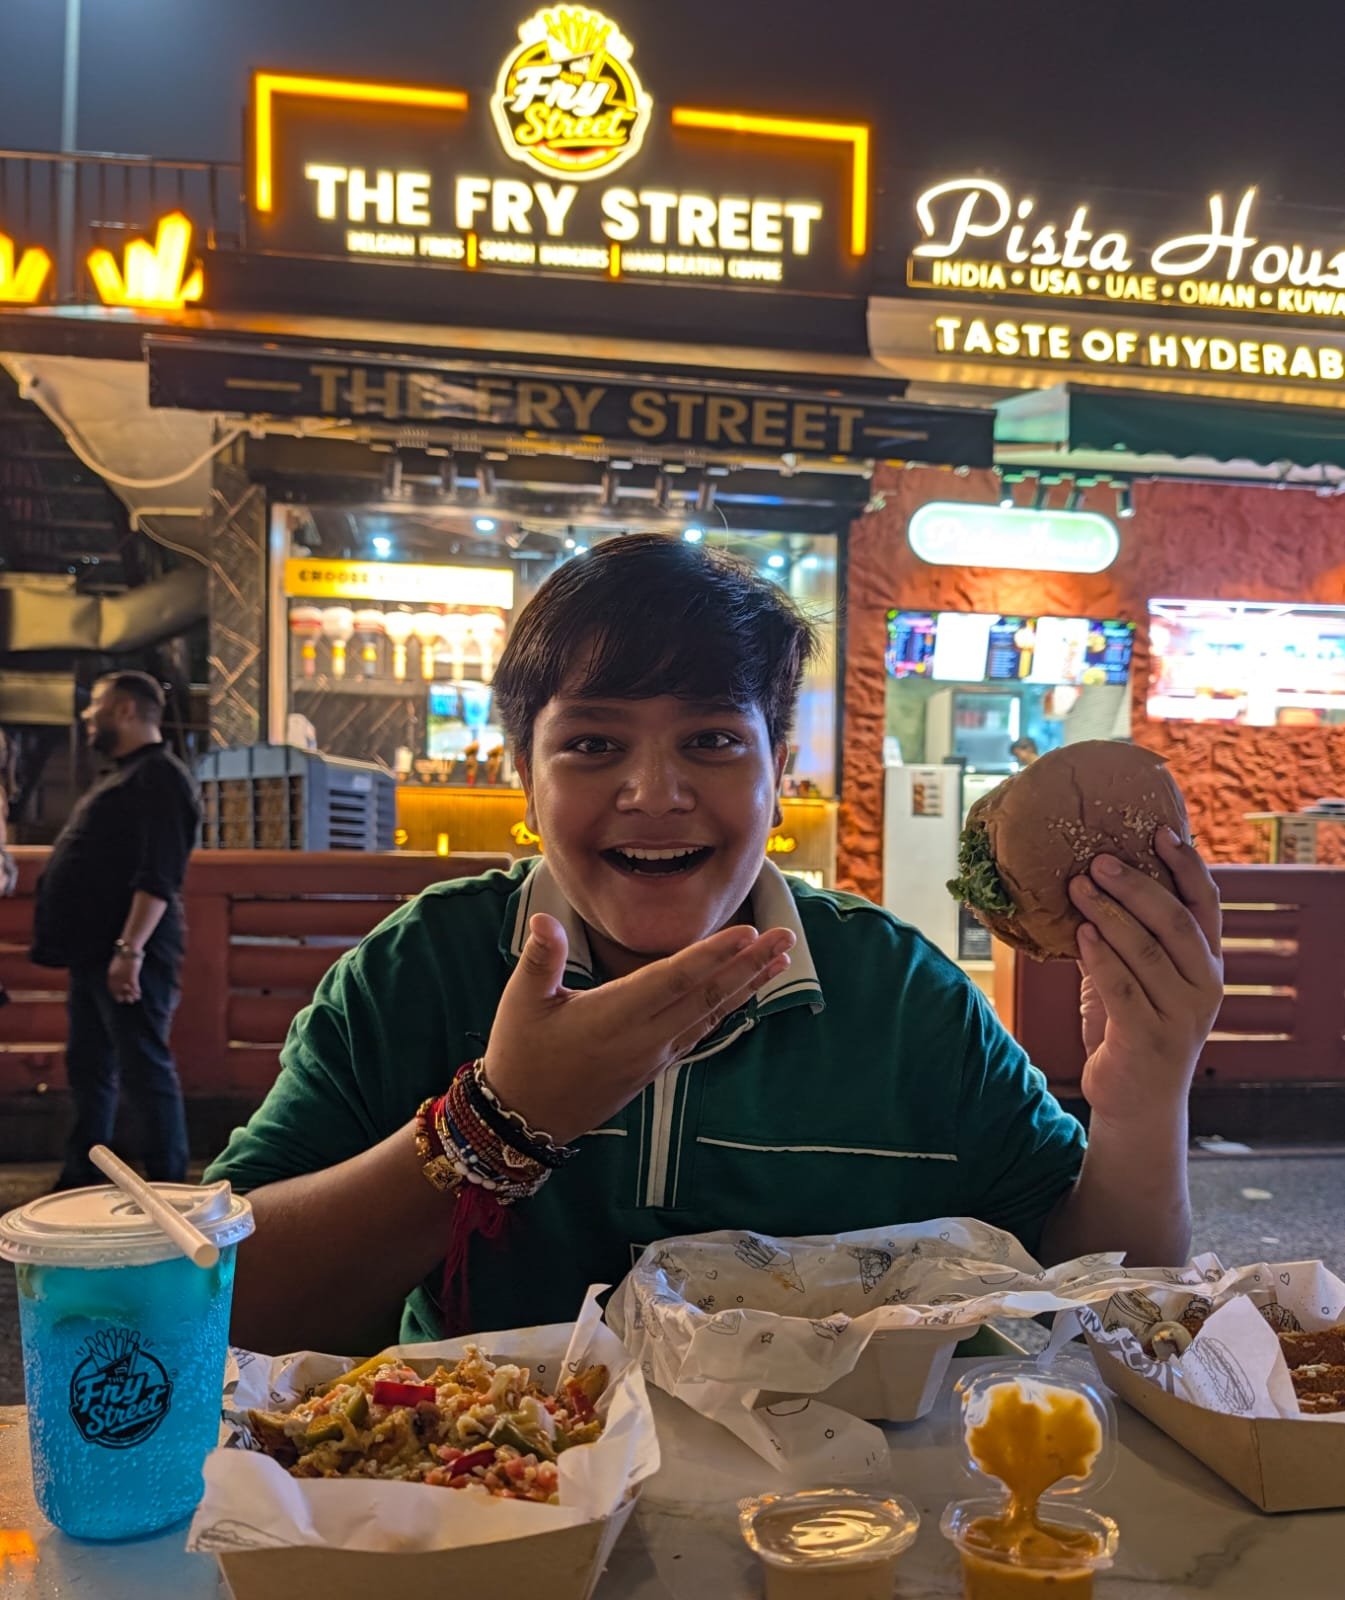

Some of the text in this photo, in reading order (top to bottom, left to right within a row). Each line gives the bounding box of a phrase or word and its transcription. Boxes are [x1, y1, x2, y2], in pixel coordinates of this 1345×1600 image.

[510, 64, 610, 117] Fry
[515, 102, 636, 142] Street
[305, 163, 822, 255] THE FRY STREET
[912, 178, 1133, 271] Pista
[932, 261, 1345, 317] INDIA USA UAE OMAN KUWA
[935, 317, 1345, 380] TASTE OF HYDERAB
[309, 366, 864, 451] THE FRY STREET
[78, 1373, 145, 1412] Fry
[86, 1387, 167, 1435] Street
